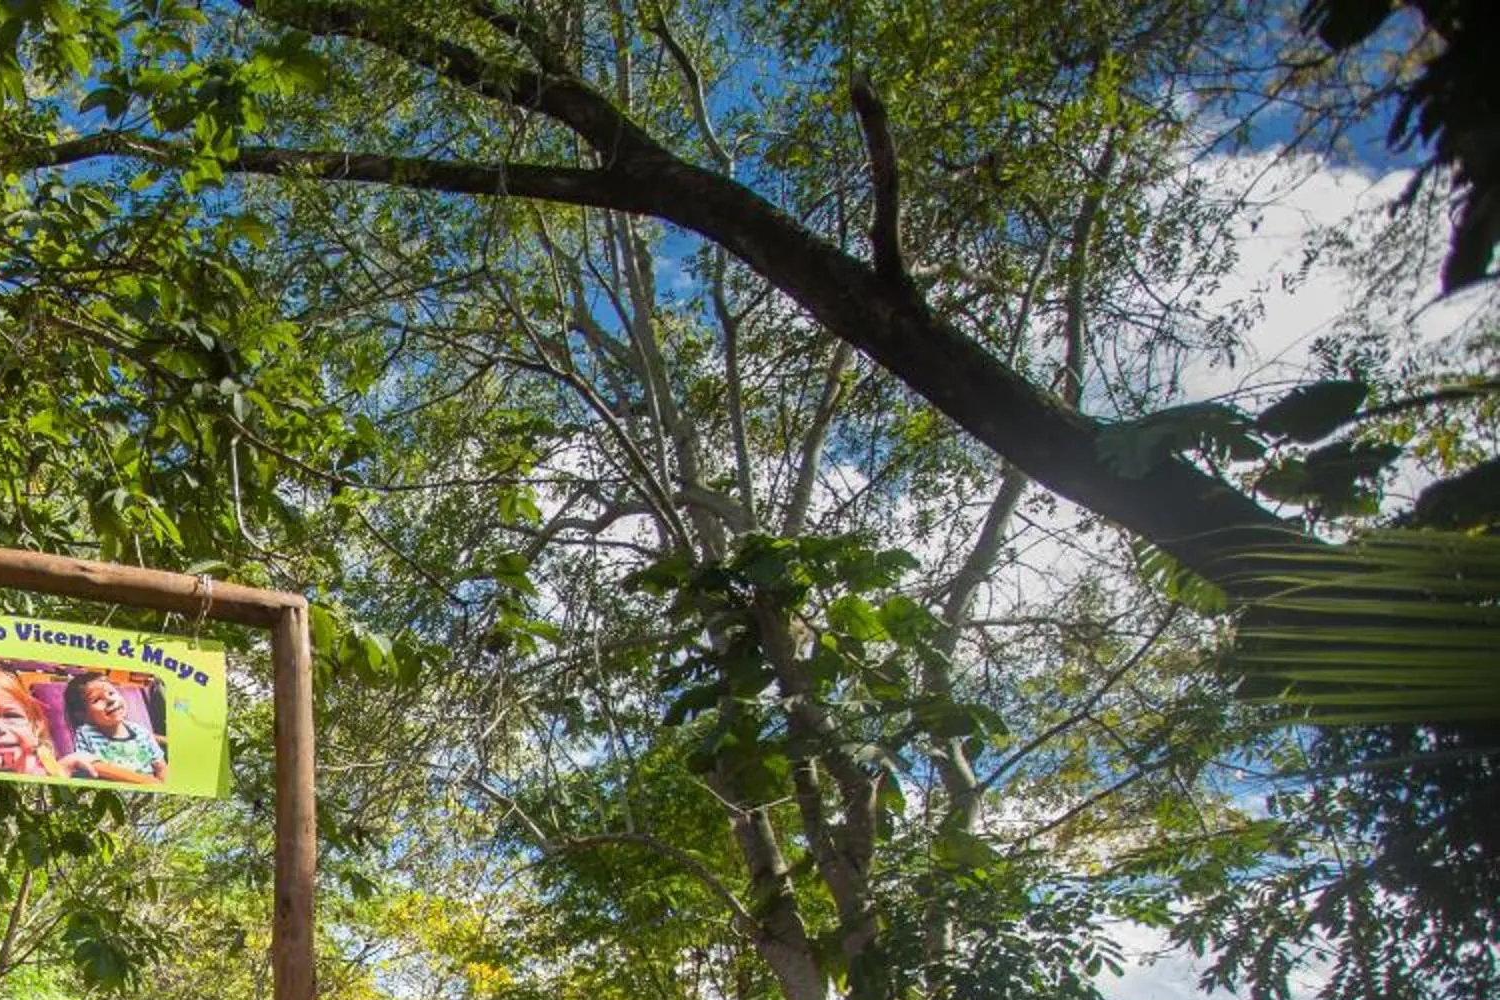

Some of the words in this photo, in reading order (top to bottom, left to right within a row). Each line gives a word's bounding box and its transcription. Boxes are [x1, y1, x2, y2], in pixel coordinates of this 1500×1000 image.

[15, 622, 110, 655] Vicente
[117, 639, 136, 658] &
[141, 643, 209, 687] Maya
